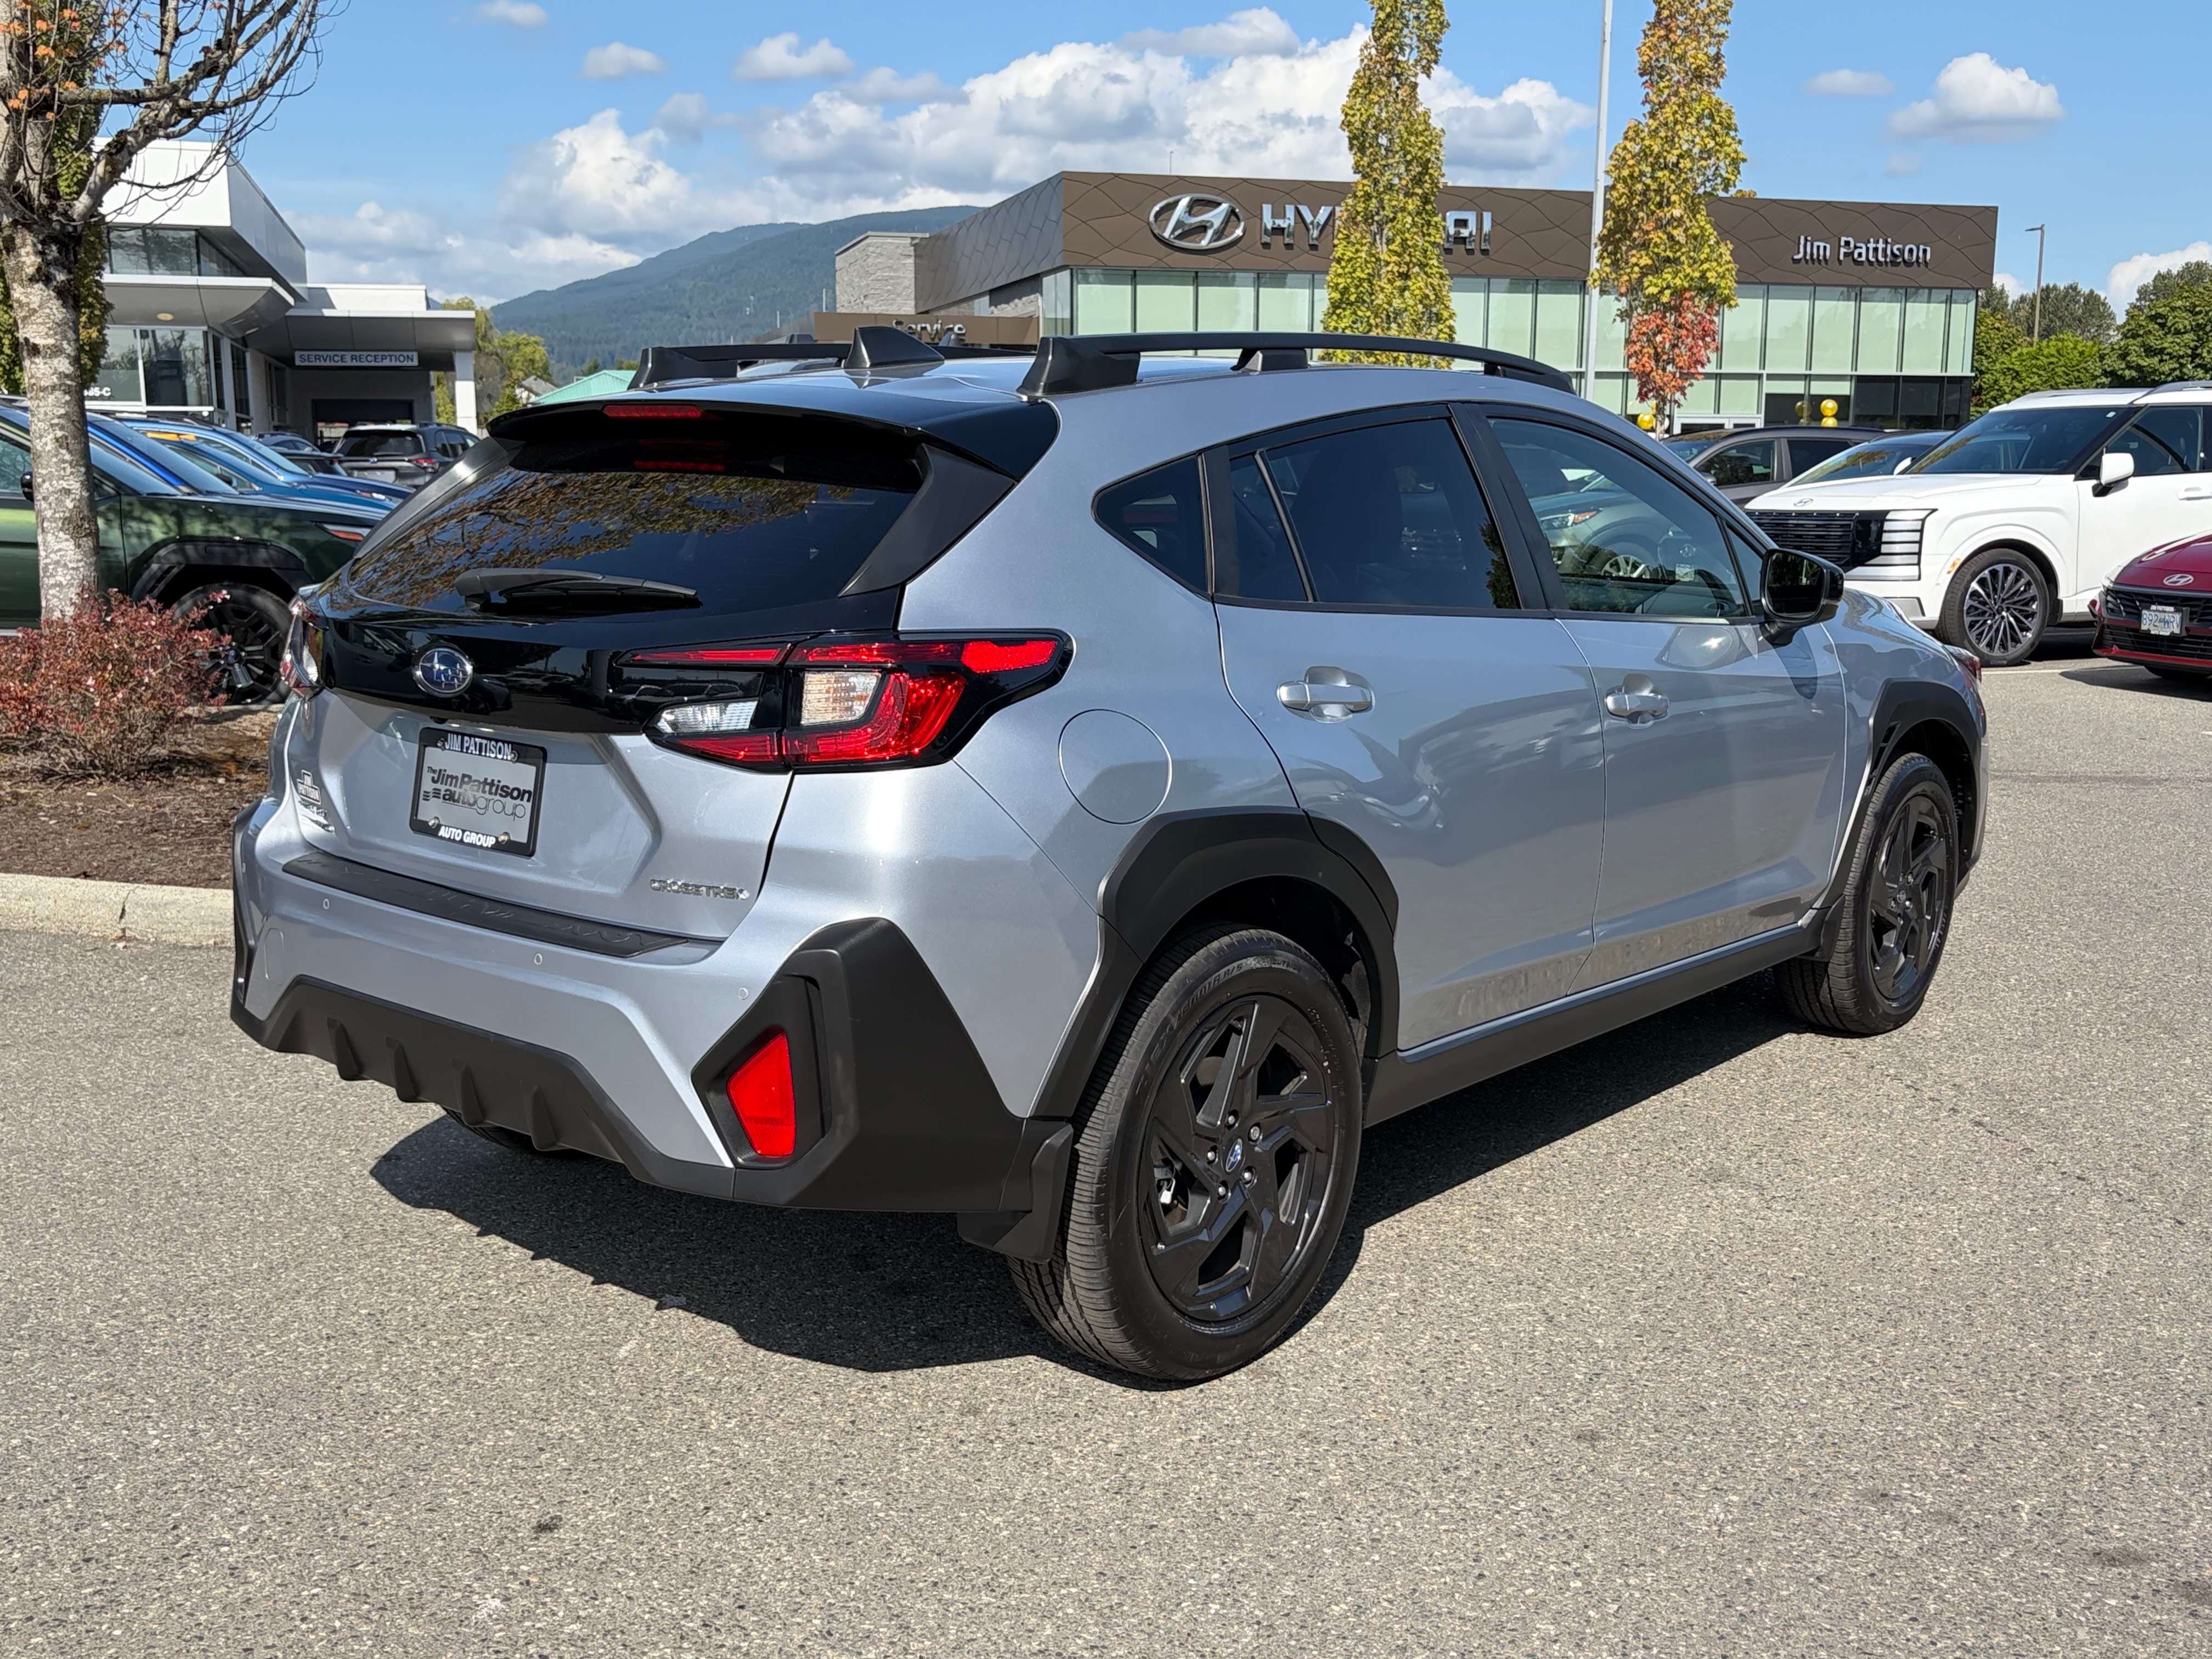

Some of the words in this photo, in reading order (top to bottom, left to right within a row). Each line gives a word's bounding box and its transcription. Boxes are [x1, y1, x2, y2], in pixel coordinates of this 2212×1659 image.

[1261, 204, 1492, 250] HYAI
[1792, 235, 1831, 260] Jim
[1839, 236, 1931, 263] Pattison
[299, 354, 347, 363] SERVICE
[350, 354, 414, 363] RECEPTION
[444, 733, 462, 751] JIM
[463, 735, 512, 760] PATTISON
[426, 766, 438, 775] The
[438, 825, 462, 842] AUTO
[462, 830, 496, 848] GROUP
